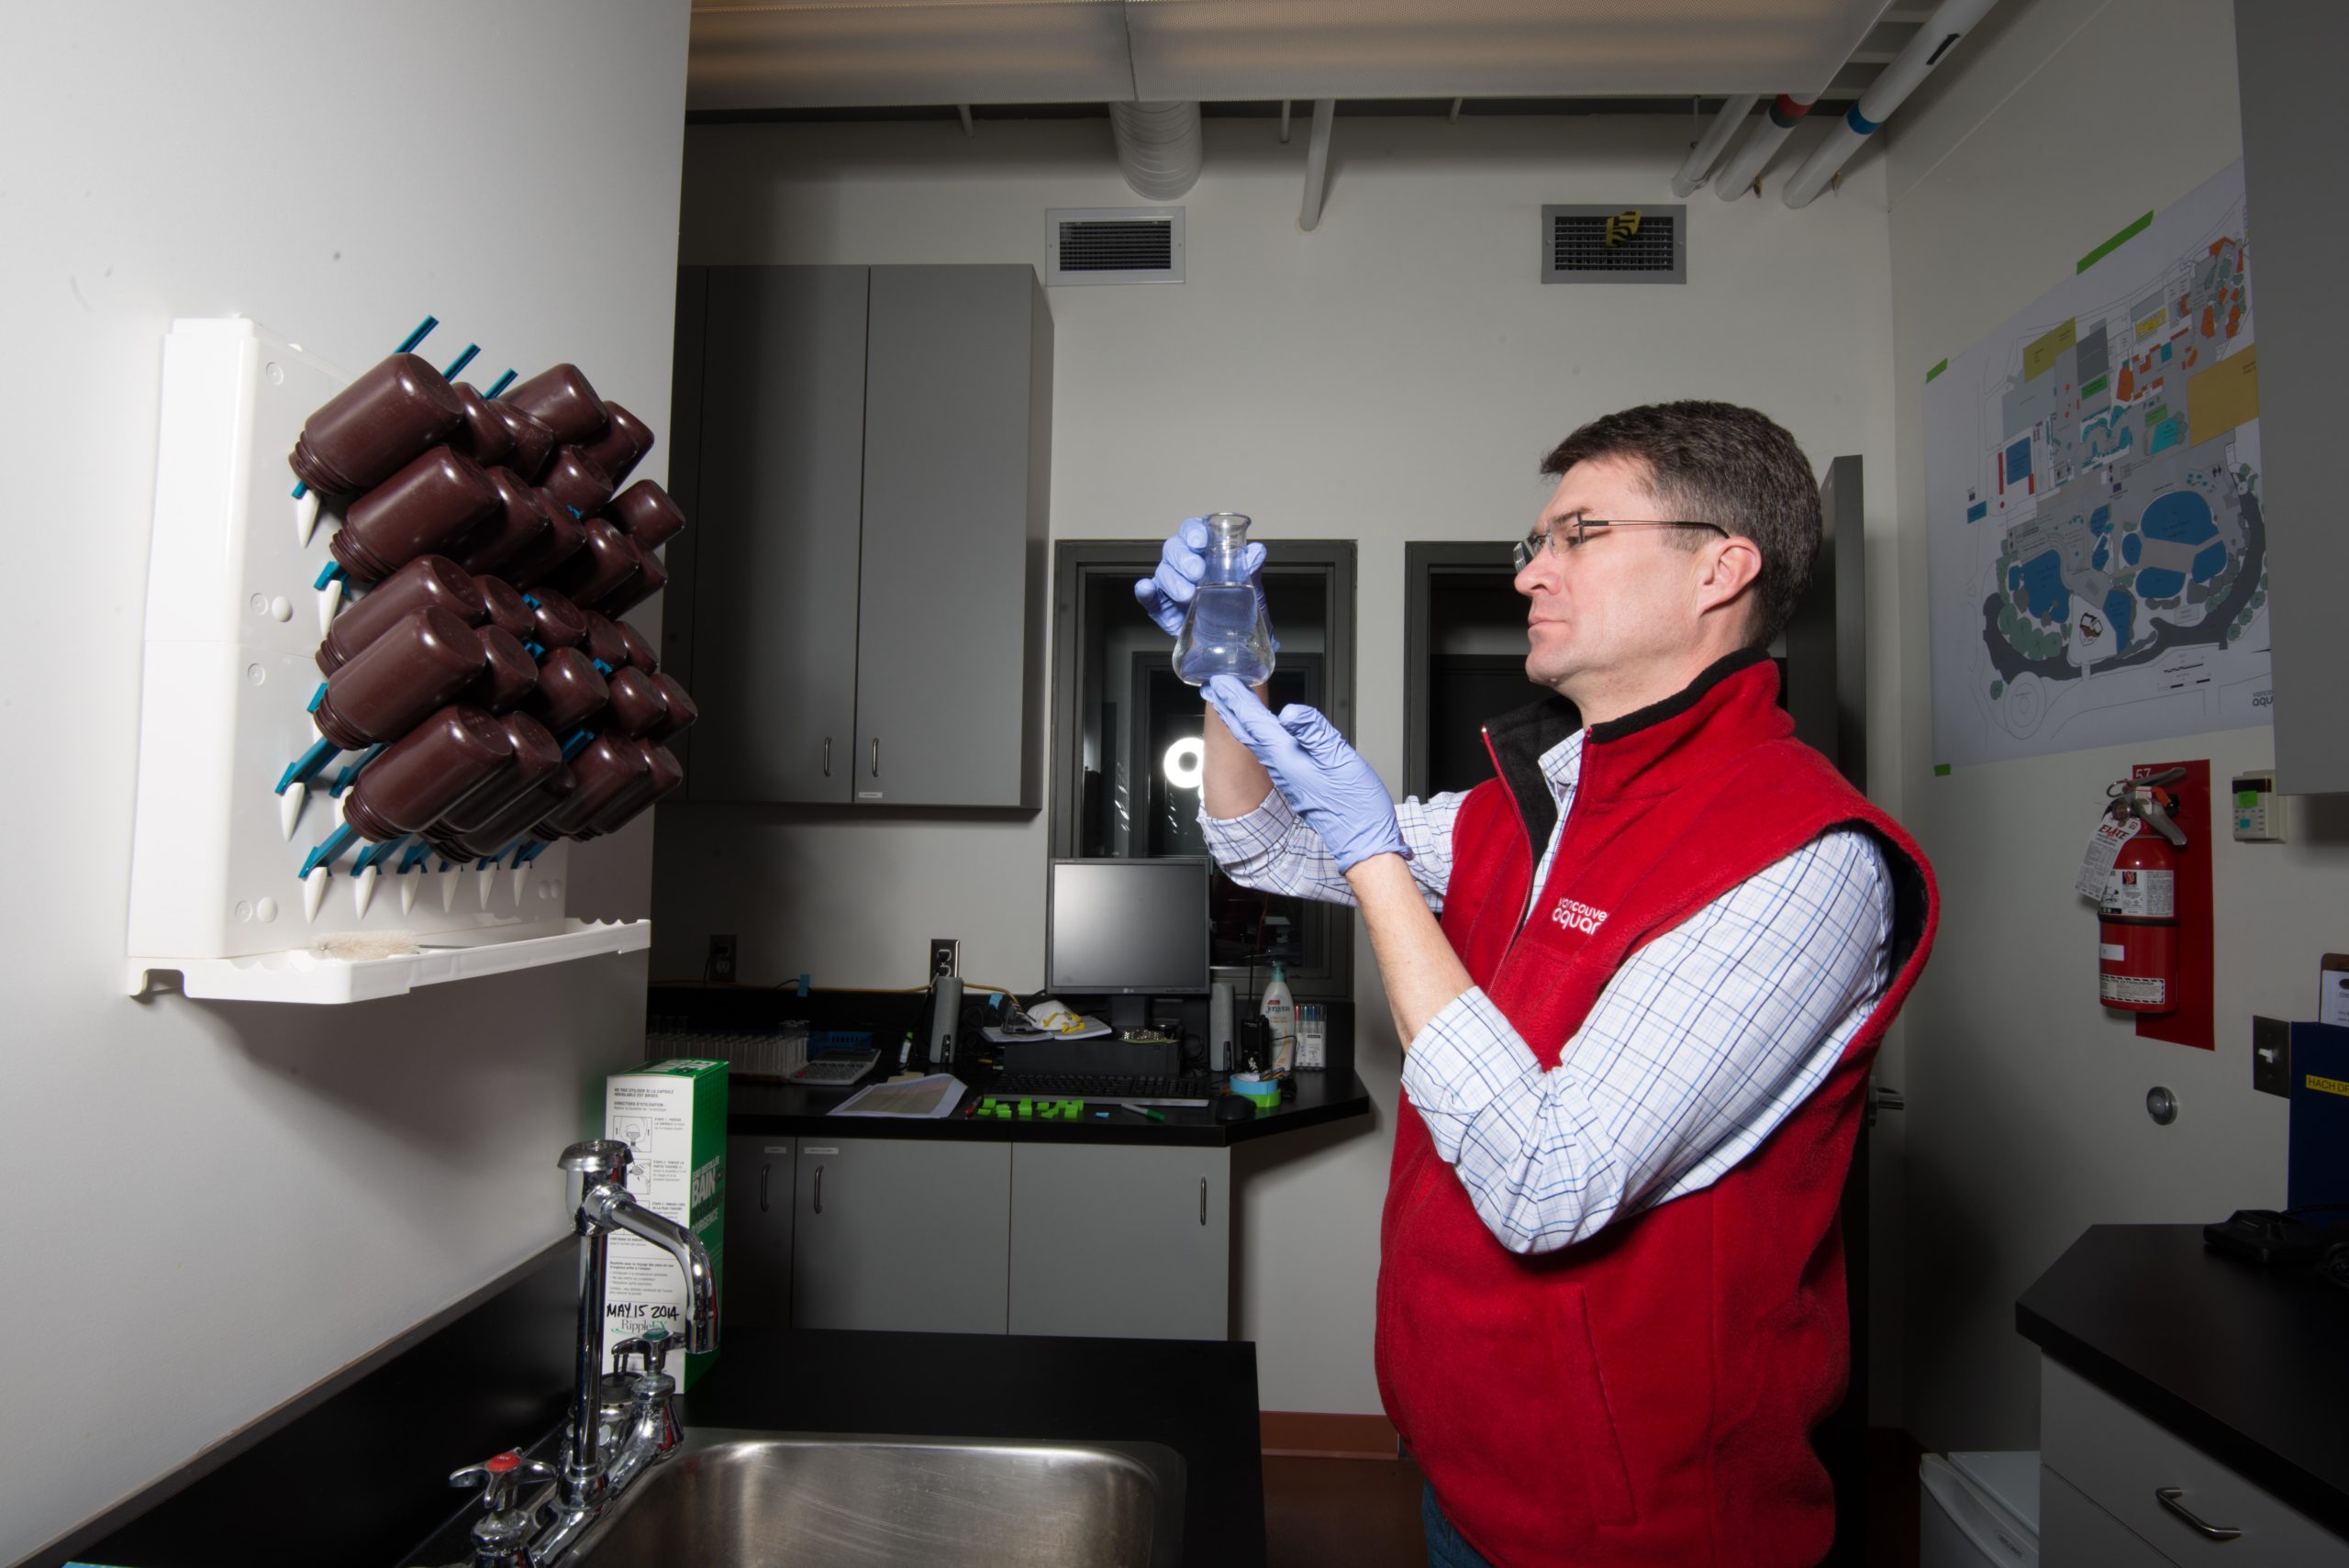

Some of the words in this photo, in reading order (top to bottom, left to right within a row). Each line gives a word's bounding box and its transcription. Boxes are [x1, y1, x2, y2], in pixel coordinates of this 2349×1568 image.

[2252, 696, 2273, 707] aqu
[2135, 767, 2152, 778] 57
[2099, 824, 2130, 840] ELITE
[1558, 897, 1609, 921] vancouve
[1552, 907, 1601, 935] aquar
[2309, 1077, 2335, 1090] HACH
[692, 1170, 716, 1207] BAIN
[607, 1302, 631, 1318] MAY
[634, 1304, 648, 1318] 15
[651, 1306, 679, 1321] 2014
